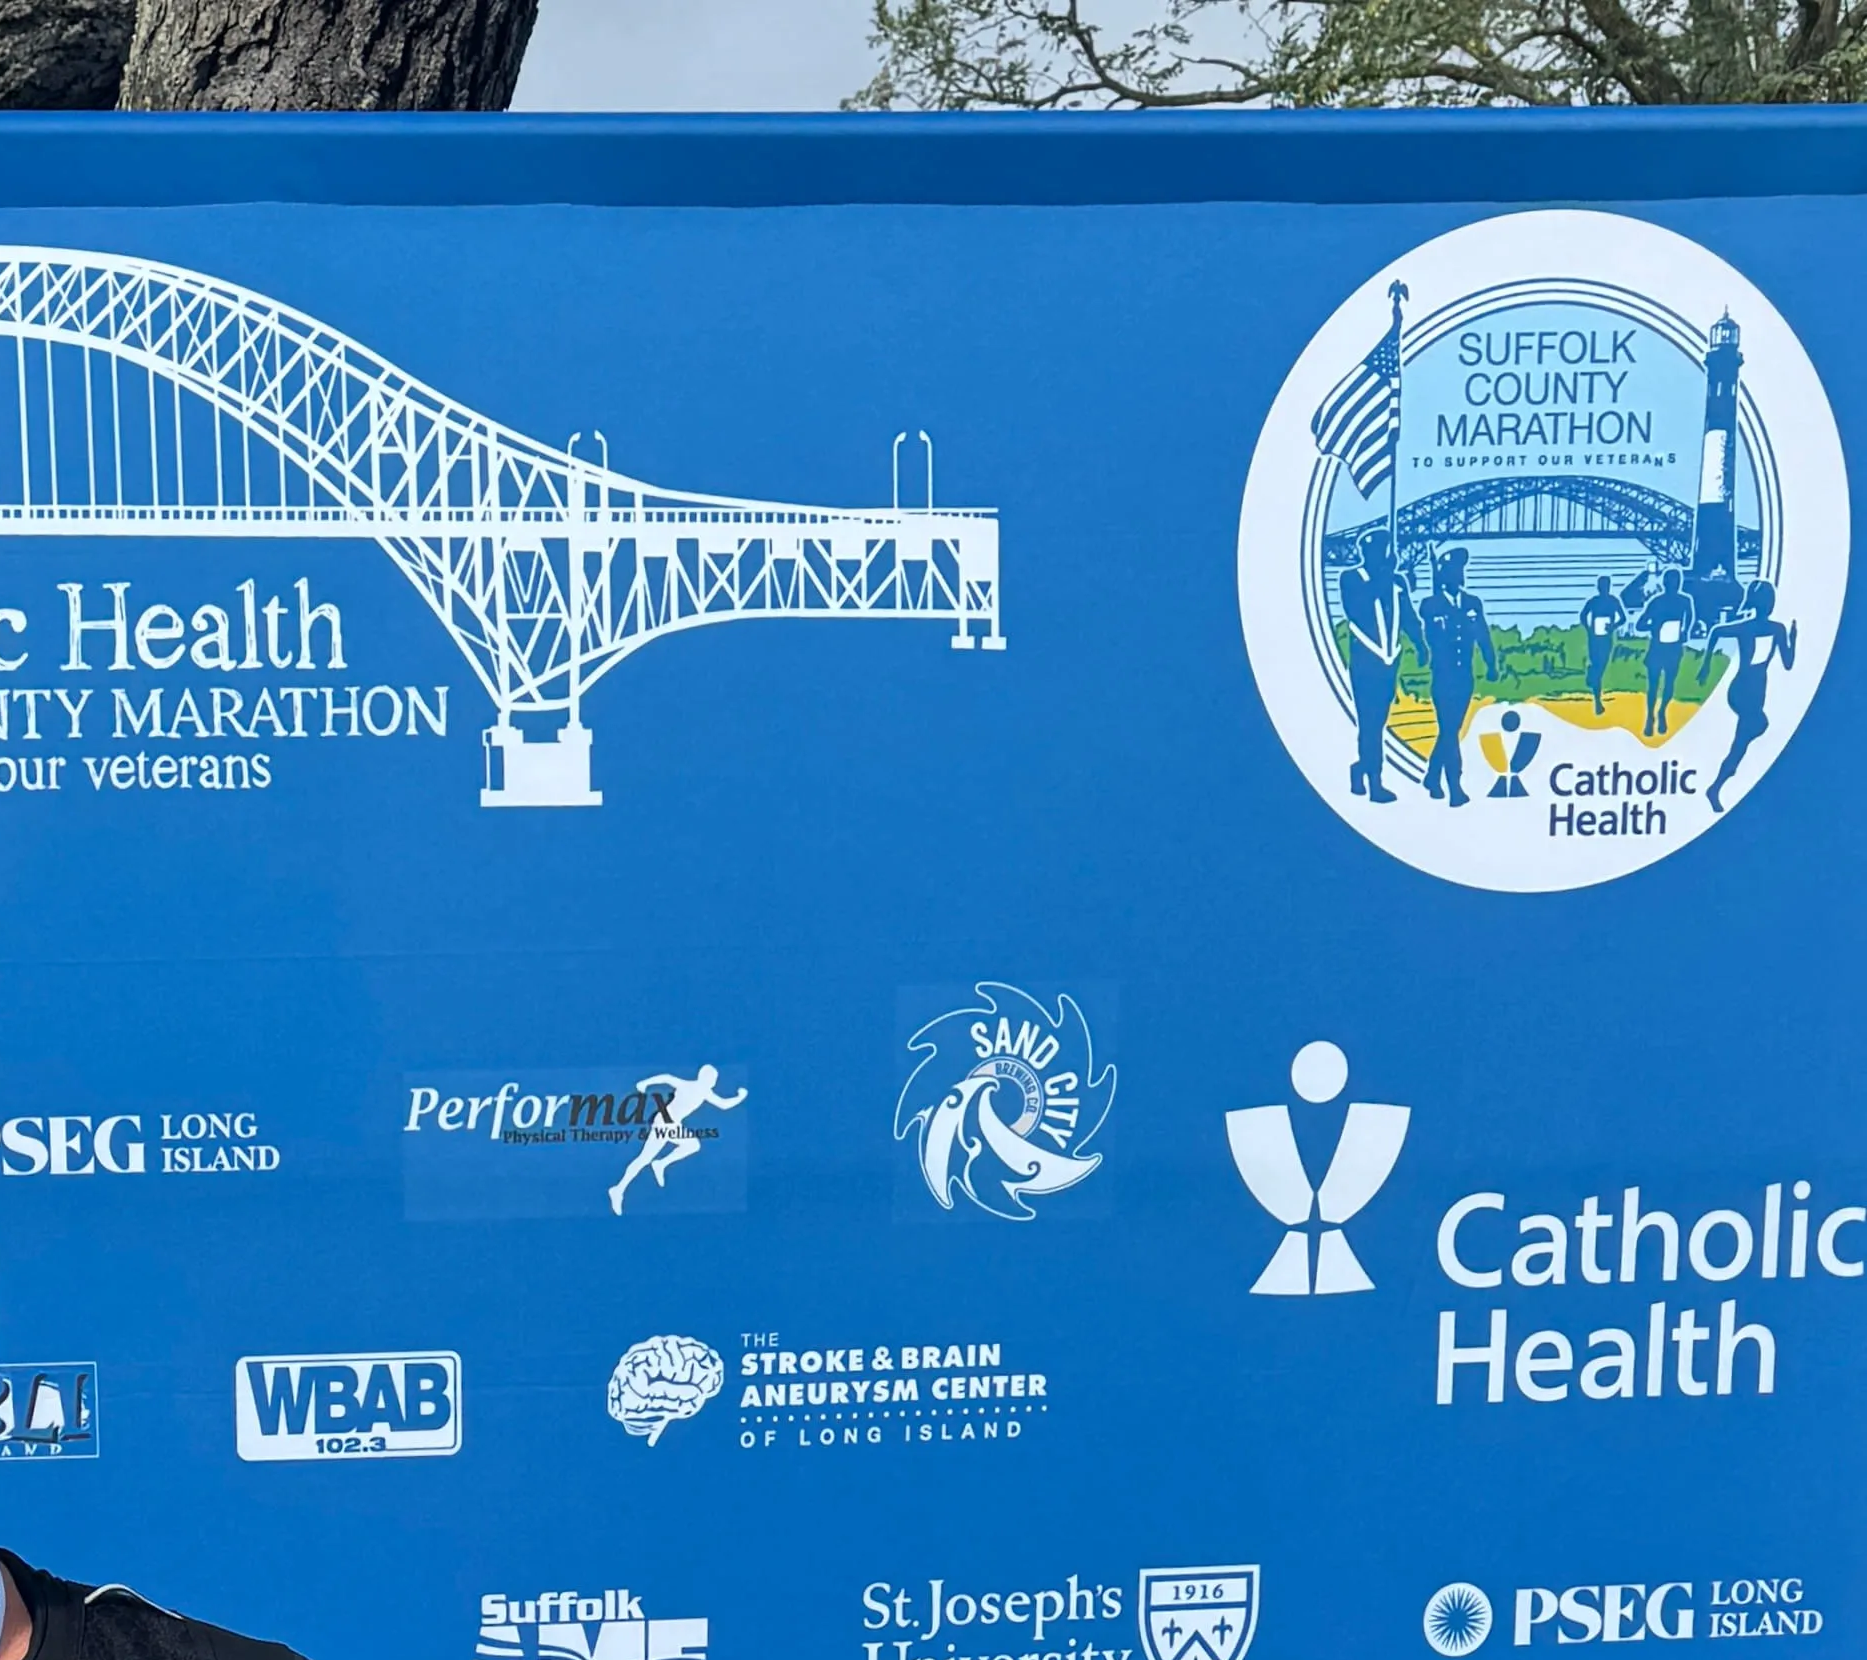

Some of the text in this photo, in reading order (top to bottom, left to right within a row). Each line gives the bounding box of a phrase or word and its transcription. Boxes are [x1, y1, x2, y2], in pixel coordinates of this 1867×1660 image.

[1458, 329, 1637, 367] SUFFOLK
[1464, 370, 1629, 407] COUNTY
[1436, 410, 1652, 447] MARATHON
[1412, 452, 1676, 469] TO SUPPORT OUR VETERANS
[56, 577, 348, 672] Health
[111, 685, 449, 739] MARATHON
[82, 751, 272, 791] veterans
[1549, 759, 1697, 797] Catholic
[1549, 800, 1667, 837] Health
[970, 1017, 1080, 1149] SAND CITY
[161, 1112, 258, 1140] LONG
[403, 1080, 674, 1141] Performax
[503, 1129, 565, 1146] Physical
[571, 1126, 633, 1145] Therapy
[653, 1124, 720, 1141] Wellness
[161, 1145, 280, 1173] ISLAND
[1437, 1180, 1867, 1289] Catholic
[740, 1332, 779, 1348] THE
[1436, 1299, 1776, 1405] Health
[741, 1343, 1001, 1376] STROKE & BRAIN
[245, 1362, 450, 1436] WBAB
[740, 1374, 1047, 1408] ANEURYSM CENTER
[315, 1437, 387, 1454] 102.3
[740, 1420, 1021, 1449] OF LONG ISLAND
[481, 1589, 645, 1625] Suffolk
[1173, 1583, 1224, 1601] 1916
[1711, 1578, 1804, 1605] LONG
[862, 1574, 1122, 1647] St. Joseph's
[1513, 1582, 1695, 1646] PSEG
[1709, 1610, 1823, 1638] ISLAND
